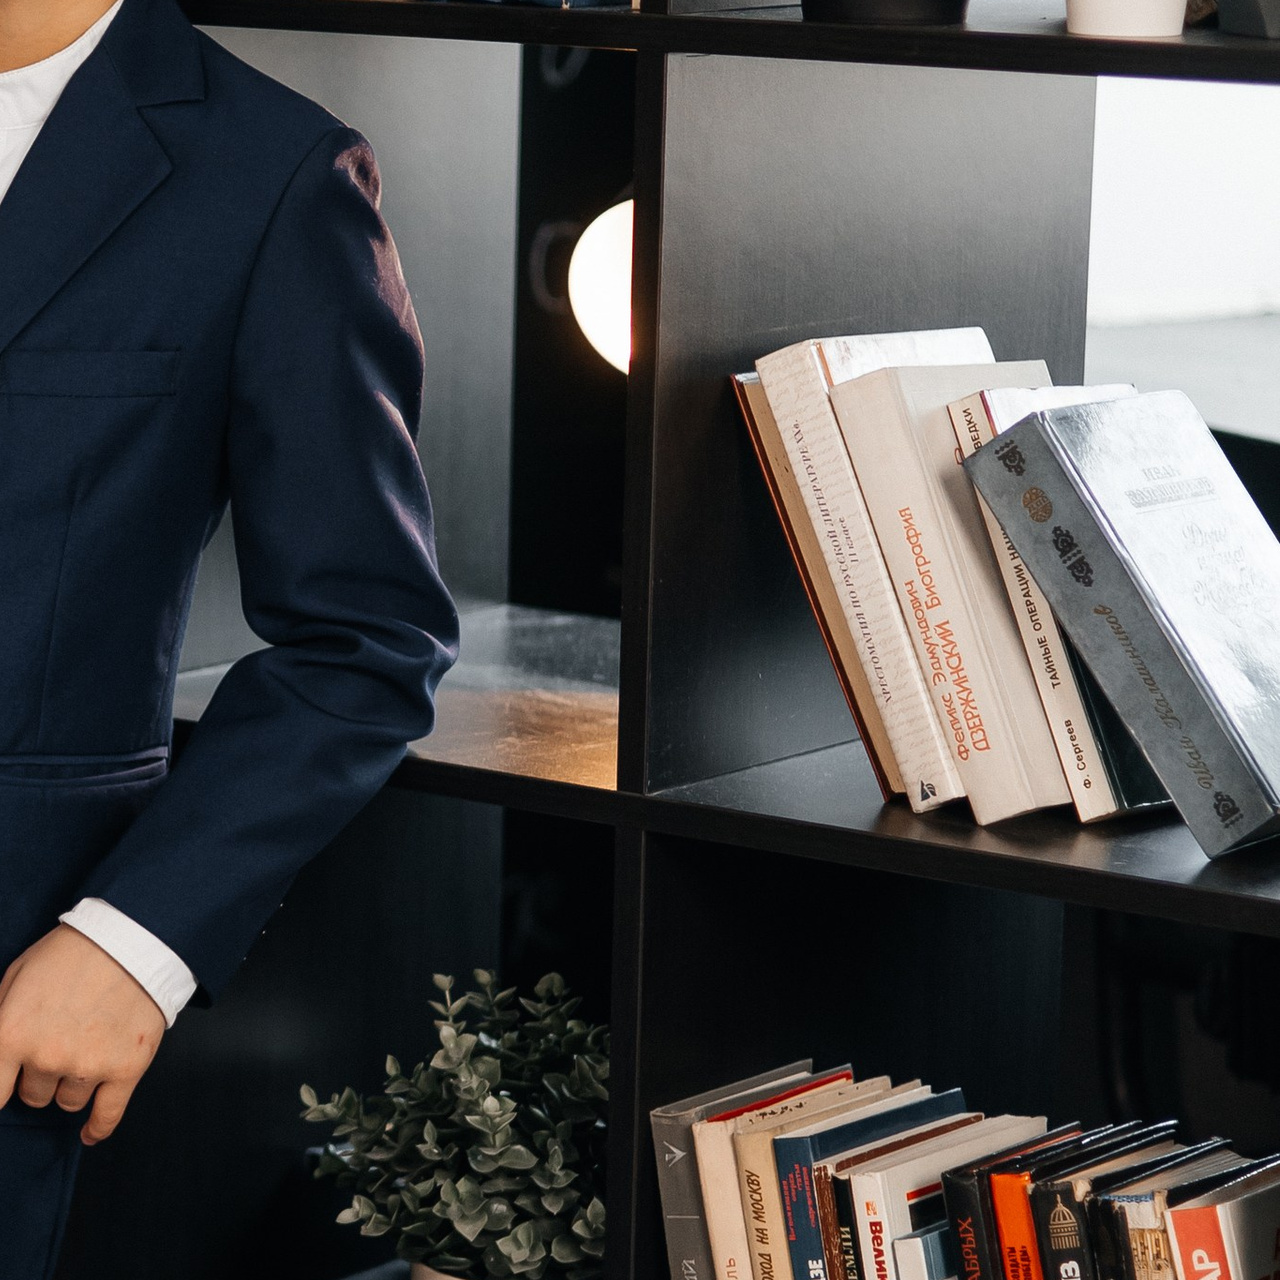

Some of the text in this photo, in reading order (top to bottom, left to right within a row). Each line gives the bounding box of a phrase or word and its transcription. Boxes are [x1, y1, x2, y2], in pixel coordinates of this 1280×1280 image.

[797, 445, 834, 528] ЛИТЕРАТУРЕ
[823, 527, 855, 589] РУССКОЙ
[836, 515, 855, 551] класс
[847, 589, 862, 609] ПО
[896, 505, 991, 752] ДЗЕРЖИНСКИЙ Биография
[1011, 563, 1063, 689] ТАЙНЫЕ ОПЕРАЦИИ
[854, 612, 894, 703] ХРЕСТОМАТИЯ
[903, 578, 972, 761] Феликс Эдмундович
[1090, 600, 1217, 793] Иван Калашников
[1061, 718, 1094, 789] Ф. Сергеев
[744, 1167, 766, 1224] МОСКВУ
[754, 1227, 769, 1246] НА
